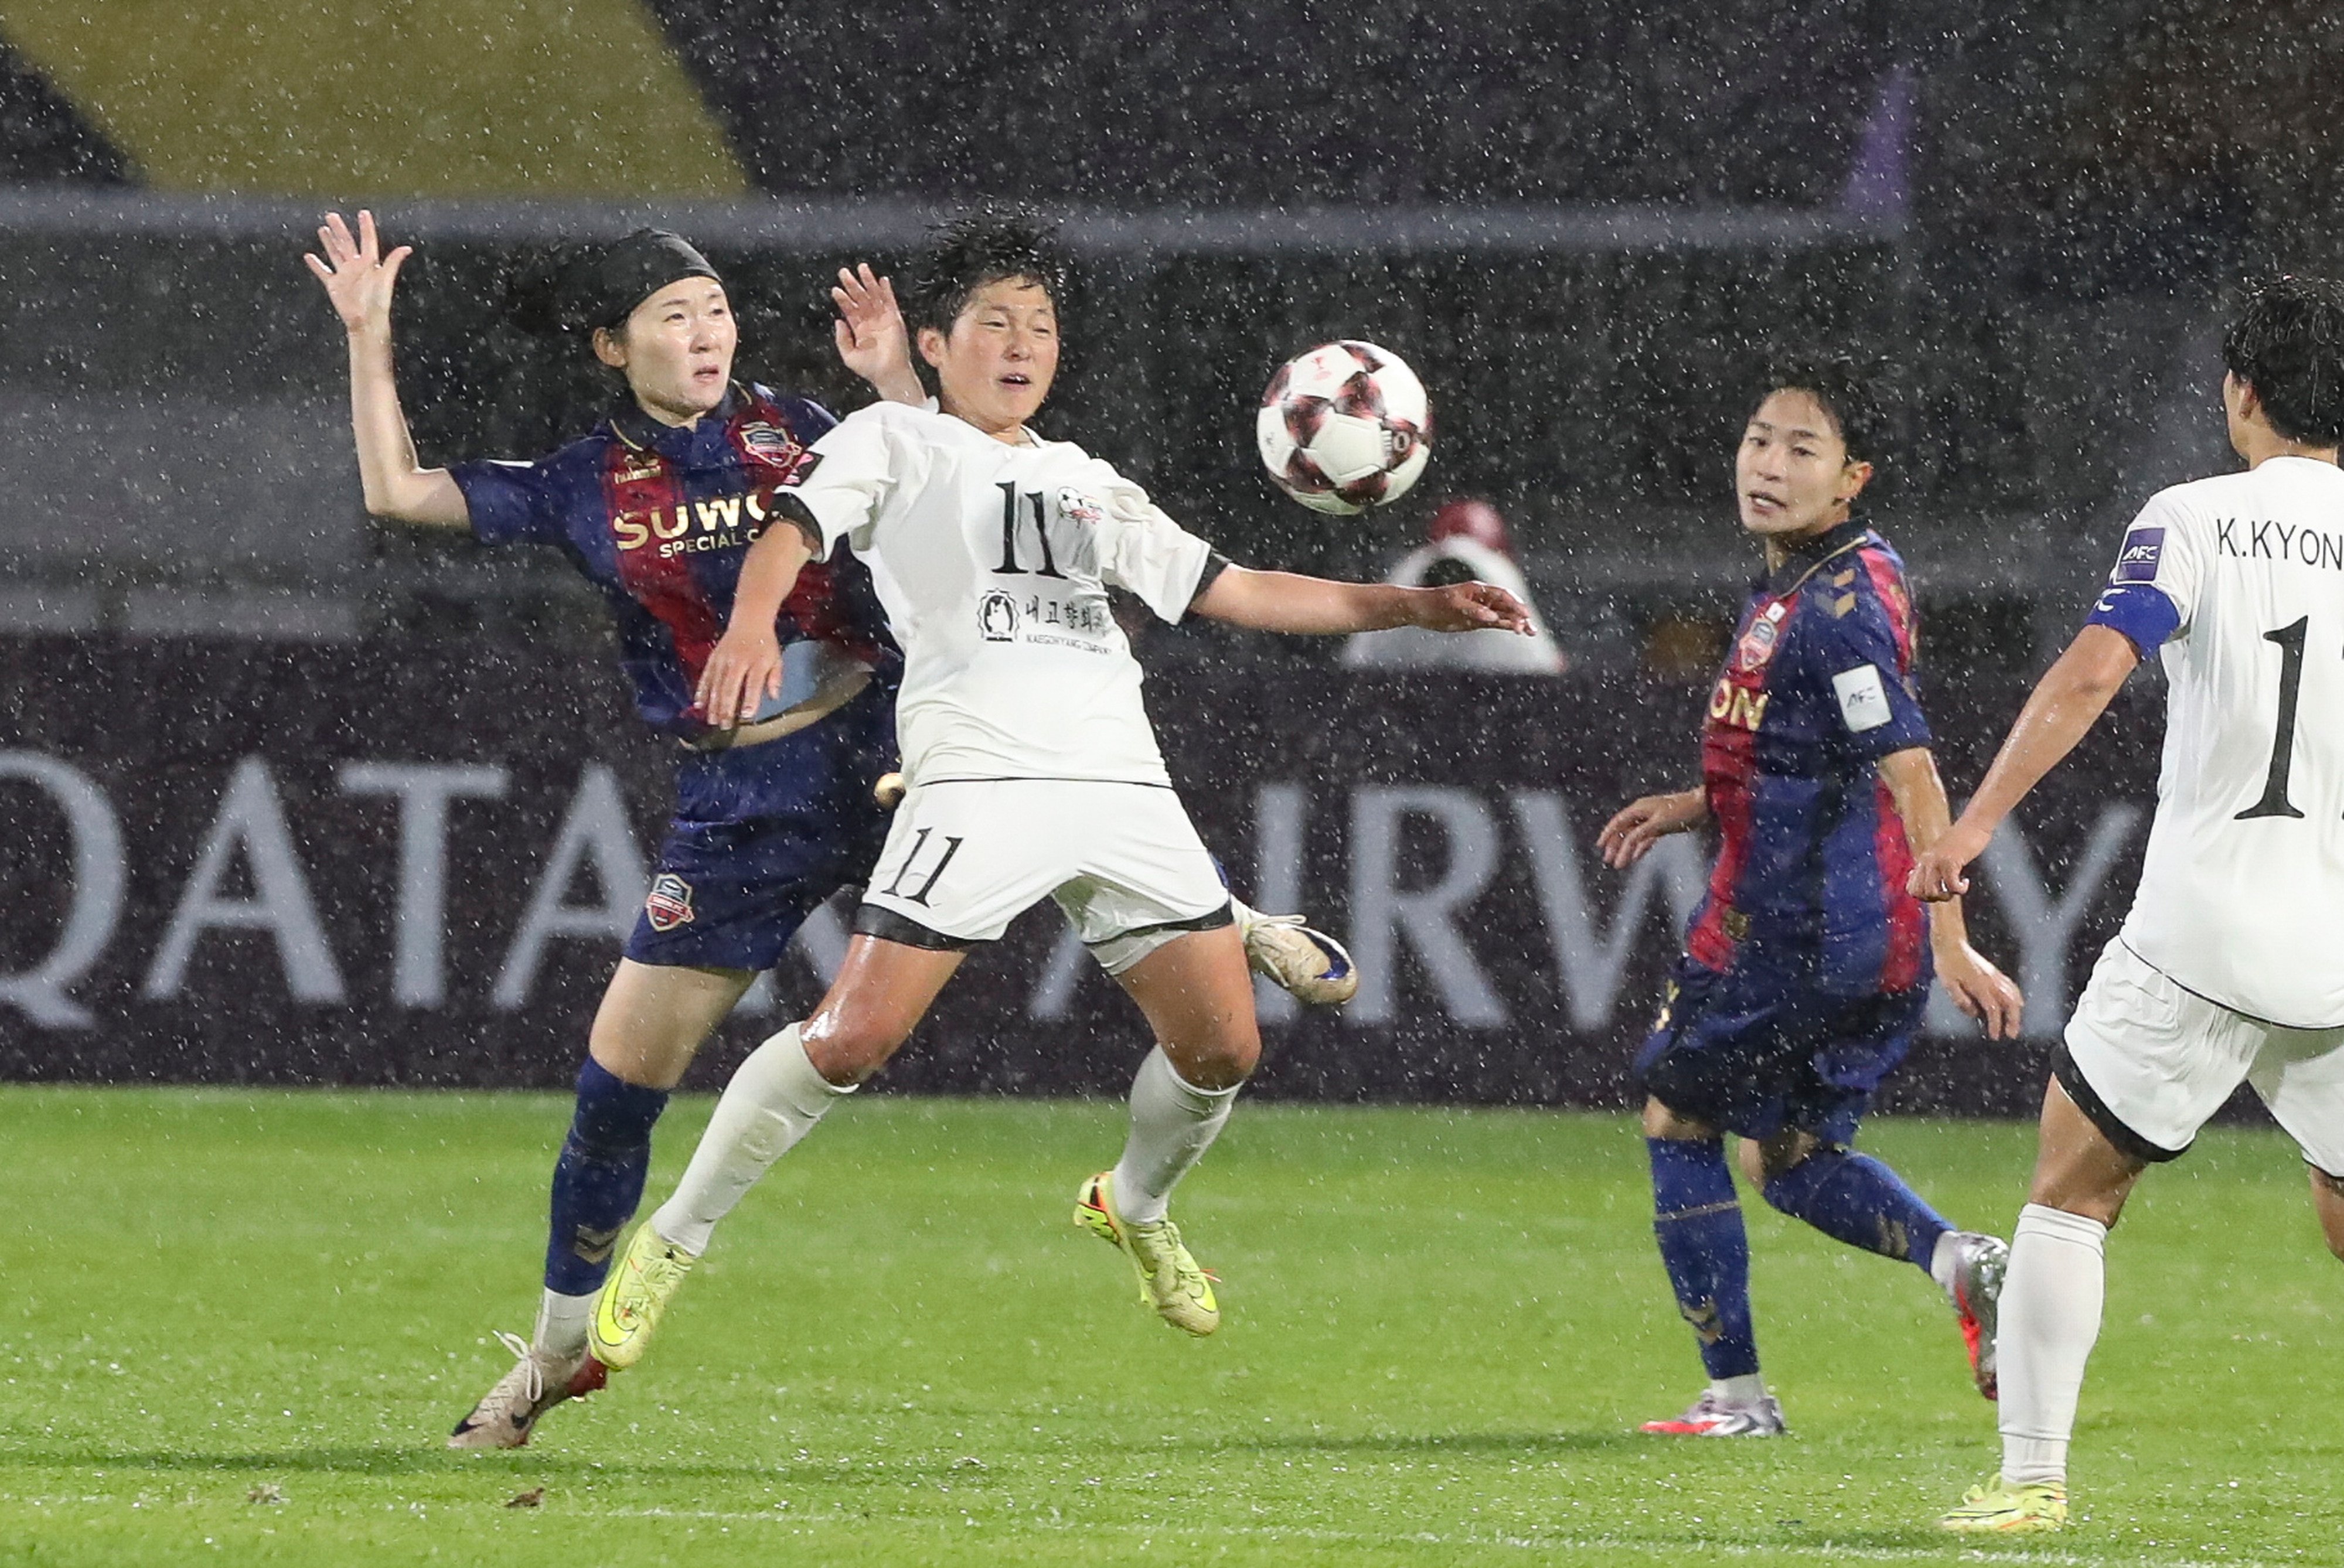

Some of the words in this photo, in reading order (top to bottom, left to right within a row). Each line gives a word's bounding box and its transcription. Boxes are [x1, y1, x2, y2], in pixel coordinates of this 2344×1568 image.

[659, 529, 742, 558] SPECIAL
[992, 480, 1068, 580] 11
[2122, 546, 2158, 561] AFC
[881, 826, 964, 909] 11
